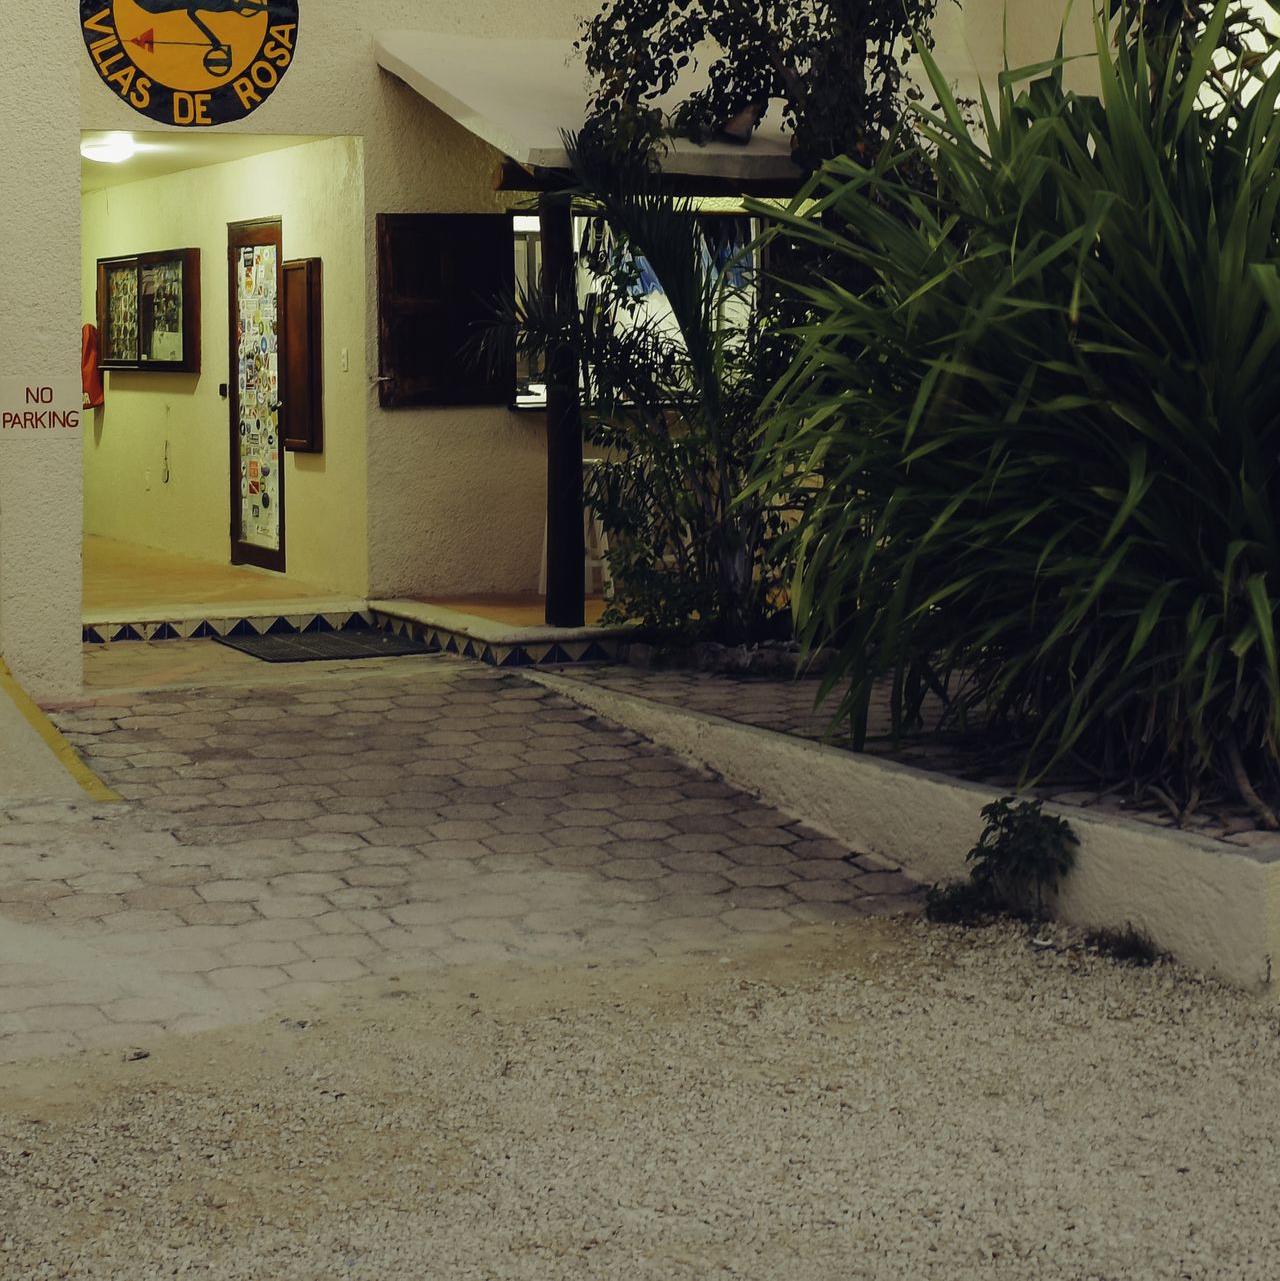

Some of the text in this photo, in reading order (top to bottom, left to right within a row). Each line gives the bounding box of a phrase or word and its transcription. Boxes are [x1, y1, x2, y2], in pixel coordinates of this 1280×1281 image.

[83, 7, 297, 125] VILLAS DE ROSA
[25, 386, 53, 404] NO
[2, 410, 80, 429] PARKING
